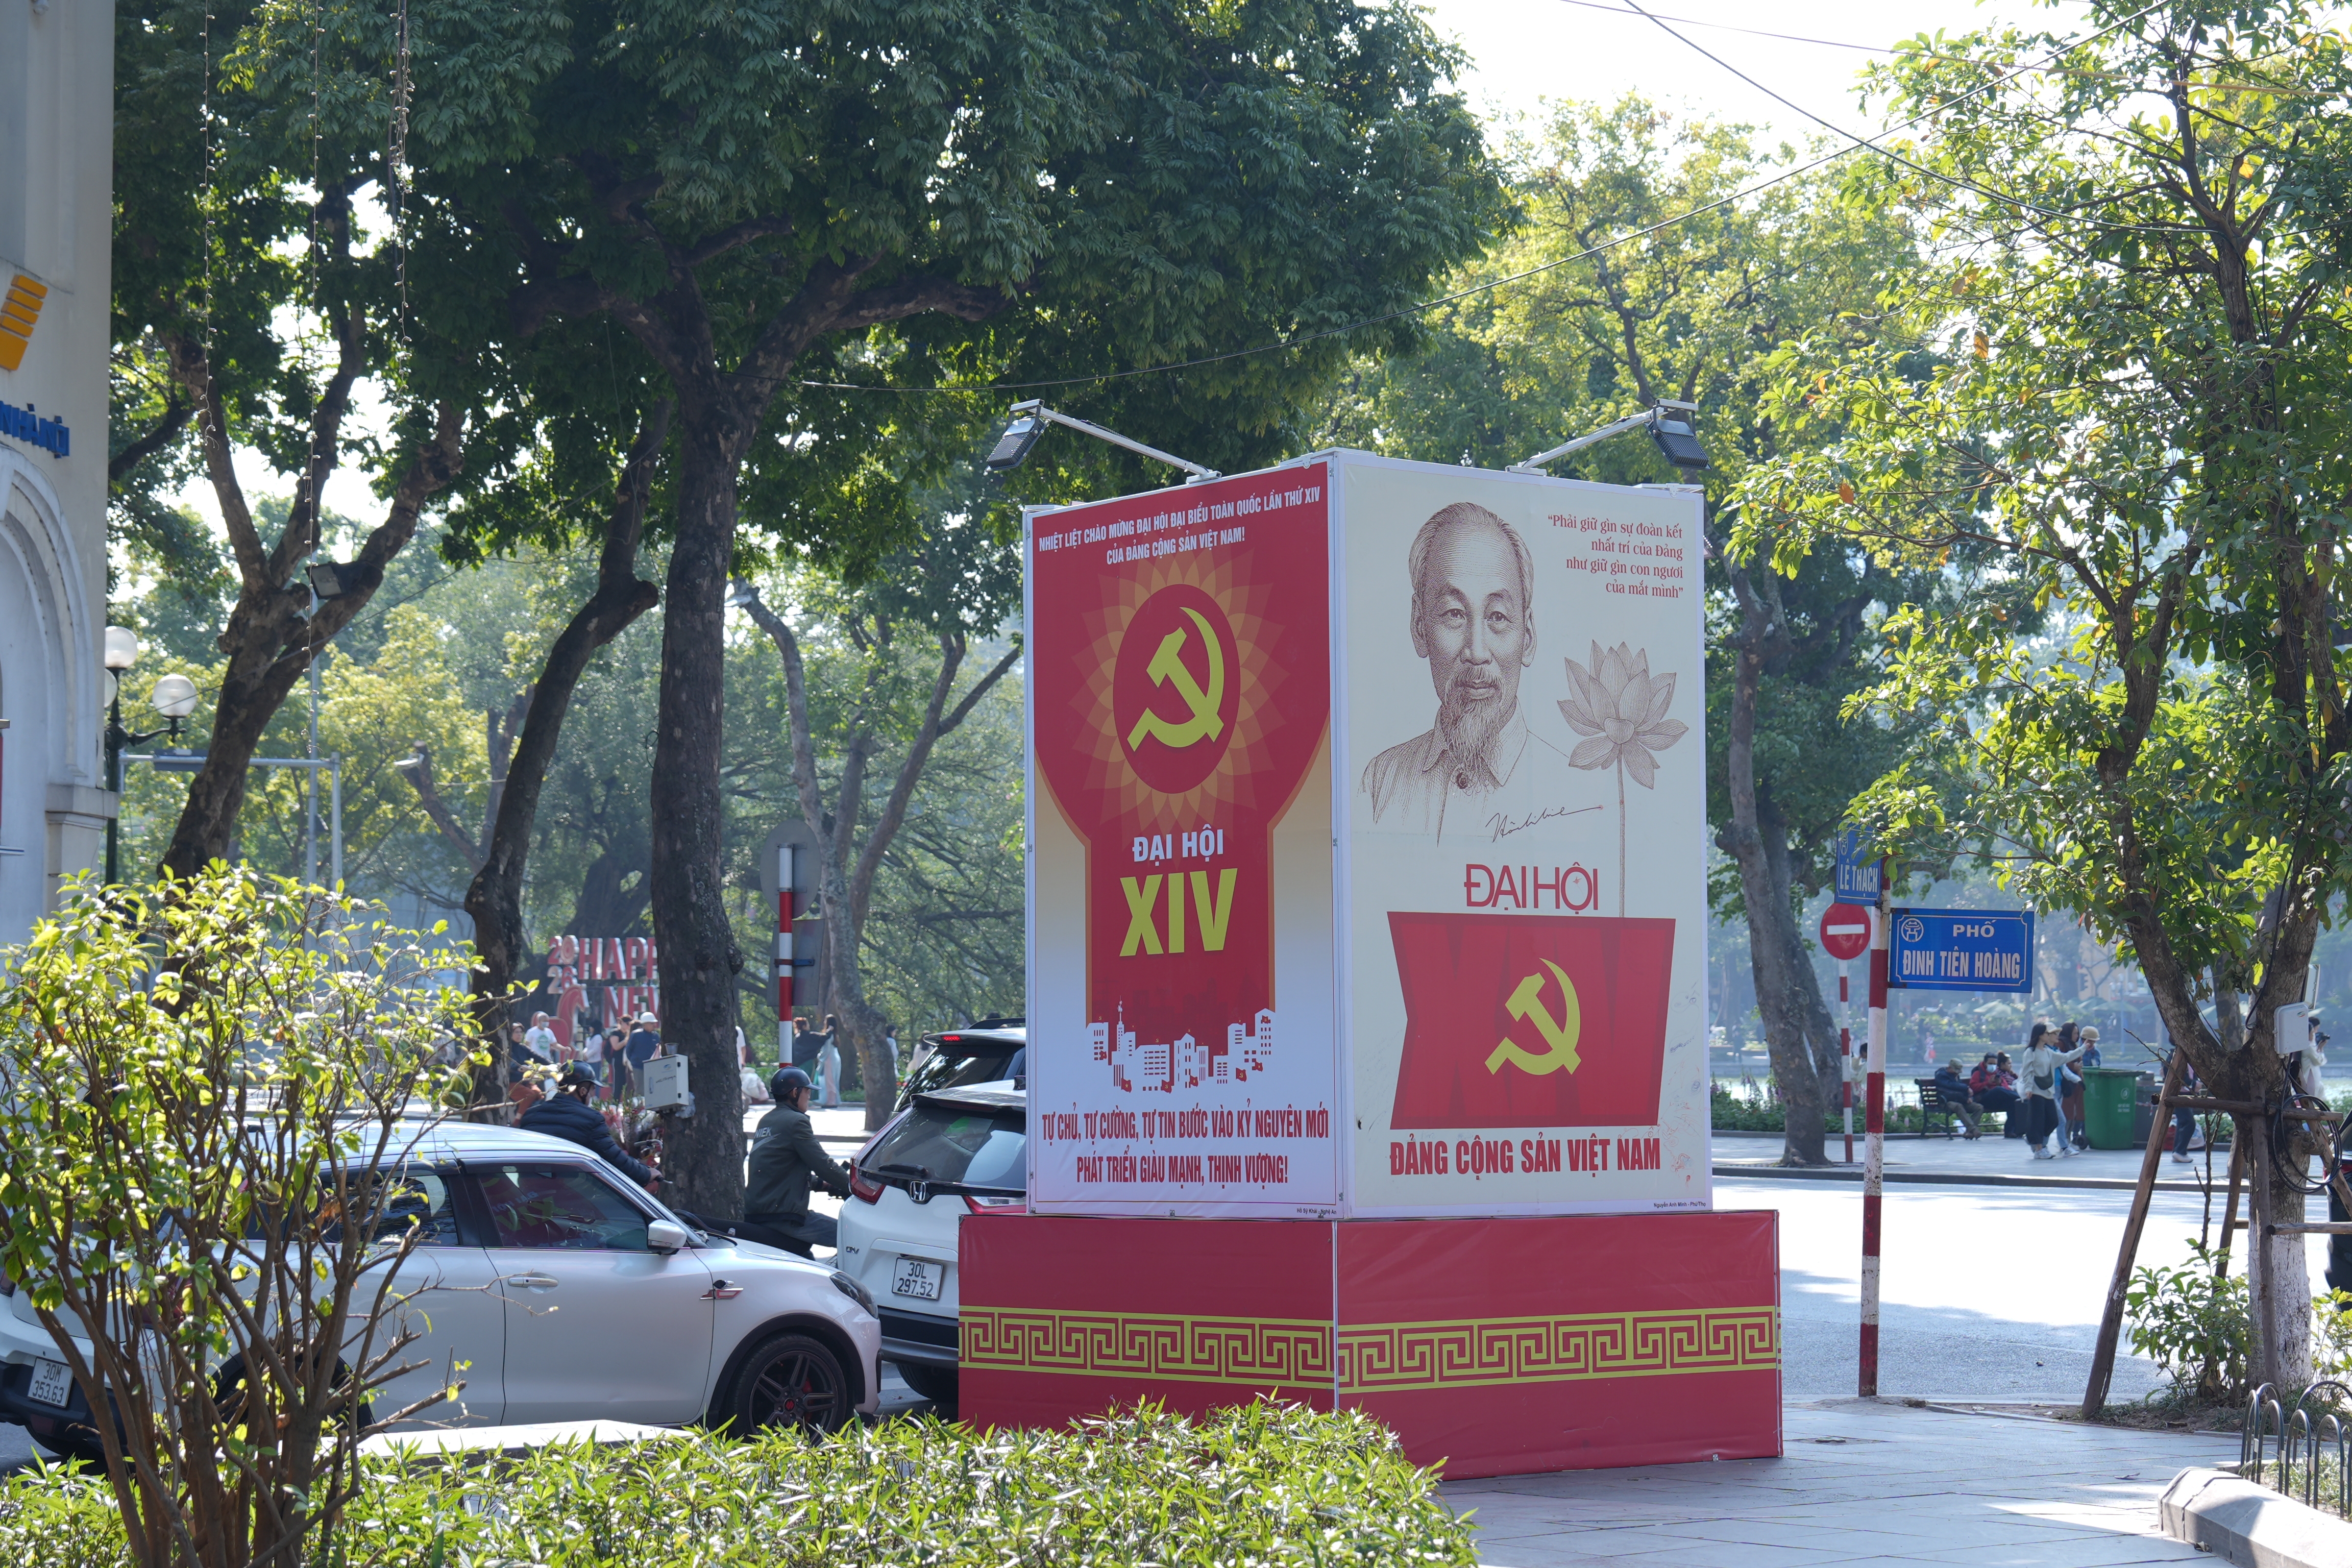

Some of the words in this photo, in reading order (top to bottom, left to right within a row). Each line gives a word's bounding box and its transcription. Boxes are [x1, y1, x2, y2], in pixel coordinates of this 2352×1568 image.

[1039, 532, 1063, 552] NHIỆT
[1065, 528, 1082, 549] LIỆT
[1084, 524, 1106, 544] CHÀO
[1109, 519, 1134, 539] MỪNG
[1137, 517, 1151, 535] ĐẠI
[1154, 511, 1168, 532] HỘI
[1170, 511, 1185, 529] ĐẠI
[1188, 502, 1208, 525] BIỂU
[1211, 500, 1234, 520] TOÀN
[1237, 493, 1261, 517] QUỐC
[1264, 489, 1282, 511] LẦN
[1284, 485, 1304, 507] THỨ
[1305, 486, 1320, 504] XIV
[1580, 517, 1597, 532] giữ
[1600, 518, 1617, 534] gìn
[1620, 522, 1633, 537] sự
[1636, 523, 1663, 537] đoàn
[1666, 523, 1683, 538] kết
[1107, 543, 1124, 565] CỦA
[1126, 540, 1149, 561] ĐẢNG
[1152, 538, 1176, 559] CỘNG
[1178, 530, 1196, 552] SẢN
[1199, 529, 1218, 551] VIỆT
[1220, 526, 1245, 545] NAM!
[1591, 536, 1615, 552] nhất
[1618, 541, 1630, 554] trí
[1633, 541, 1652, 556] của
[1655, 544, 1683, 561] Đảng
[1566, 556, 1587, 570] như
[1590, 558, 1608, 574] giữ
[1610, 559, 1627, 576] gìn
[1630, 564, 1650, 576] con
[1653, 566, 1683, 580] ngươi
[1606, 579, 1625, 594] của
[1628, 580, 1649, 596] mắt
[1132, 834, 1172, 867] ĐẠI
[1182, 823, 1223, 862] HỘI
[1464, 864, 1527, 911] ĐẠI
[1533, 862, 1598, 915] HỘI
[1840, 858, 1850, 890] LÊ
[1852, 866, 1878, 897] THẠCH
[1119, 868, 1238, 957] XIV
[1952, 919, 1997, 937] PHỐ
[1902, 949, 1934, 976] ĐINH
[1940, 946, 1970, 977] TIÊN
[1974, 948, 2020, 979] HOÀNG
[1042, 1111, 1056, 1146] TỰ
[1058, 1101, 1081, 1143] CHỦ,
[1084, 1110, 1098, 1145] TỰ
[1100, 1105, 1139, 1142] CƯỜNG,
[1142, 1109, 1157, 1144] TỰ
[1158, 1111, 1175, 1138] TIN
[1179, 1102, 1208, 1138] BƯỚC
[1211, 1105, 1233, 1138] VÀO
[1237, 1098, 1252, 1138] KỶ
[1255, 1104, 1302, 1138] NGUYÊN
[1306, 1101, 1329, 1138] MỚI
[1077, 1150, 1104, 1183] PHÁT
[1106, 1144, 1137, 1183] TRIỂN
[1140, 1149, 1165, 1183] GIÀU
[1168, 1156, 1204, 1189] MẠNH,
[1208, 1156, 1241, 1189] THỊNH
[1244, 1153, 1288, 1190] VƯỢNG!
[1390, 1133, 1449, 1175] ĐẢNG
[1456, 1134, 1513, 1180] CỘNG
[1521, 1131, 1561, 1173] SẢN
[1567, 1133, 1610, 1178] VIỆT
[1617, 1138, 1660, 1170] NAM
[897, 1277, 934, 1297] 297.52
[908, 1262, 927, 1279] 30L
[43, 1362, 63, 1382] 30M
[32, 1380, 64, 1404] 353.63
